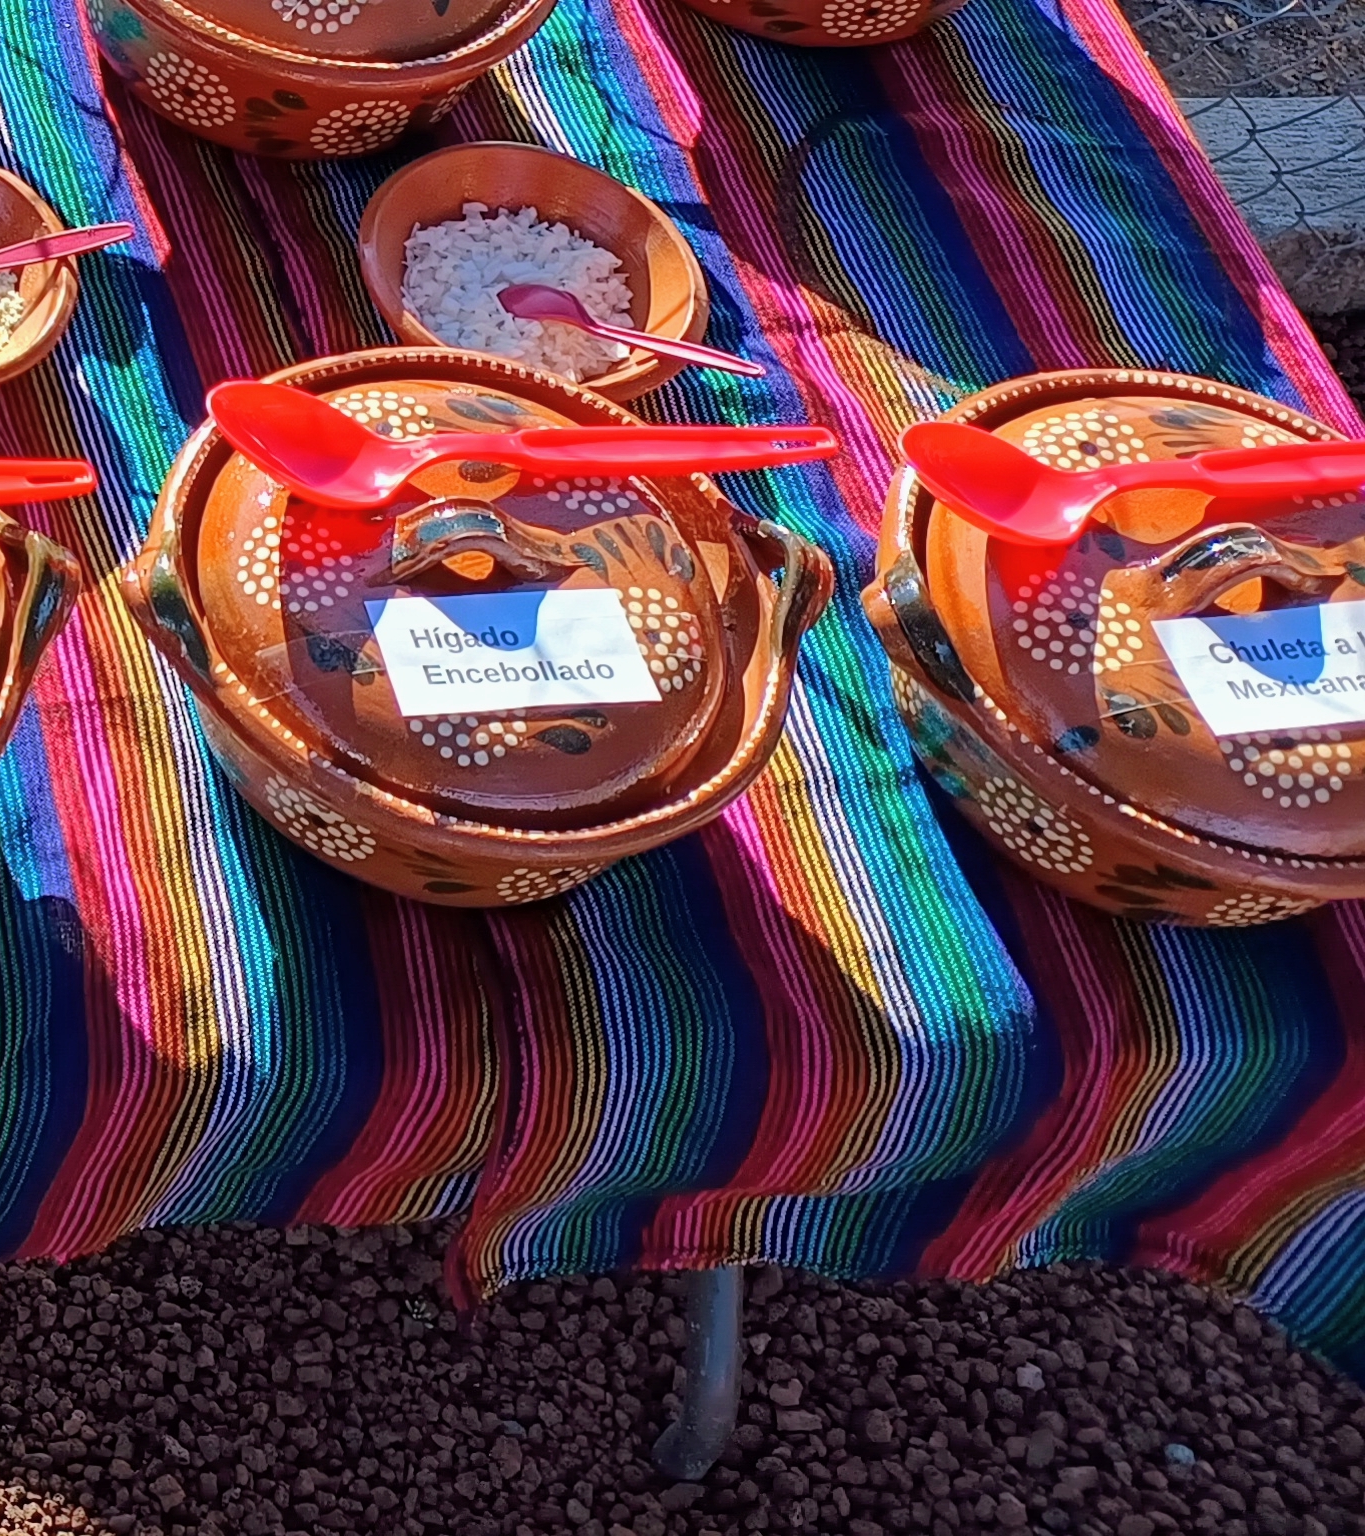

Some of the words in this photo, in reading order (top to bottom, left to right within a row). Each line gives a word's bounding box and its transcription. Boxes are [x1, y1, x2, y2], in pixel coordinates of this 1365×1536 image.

[409, 625, 519, 654] Hígado
[1209, 637, 1330, 664] Chuleta
[1334, 638, 1357, 655] a
[422, 658, 615, 685] Encebollado
